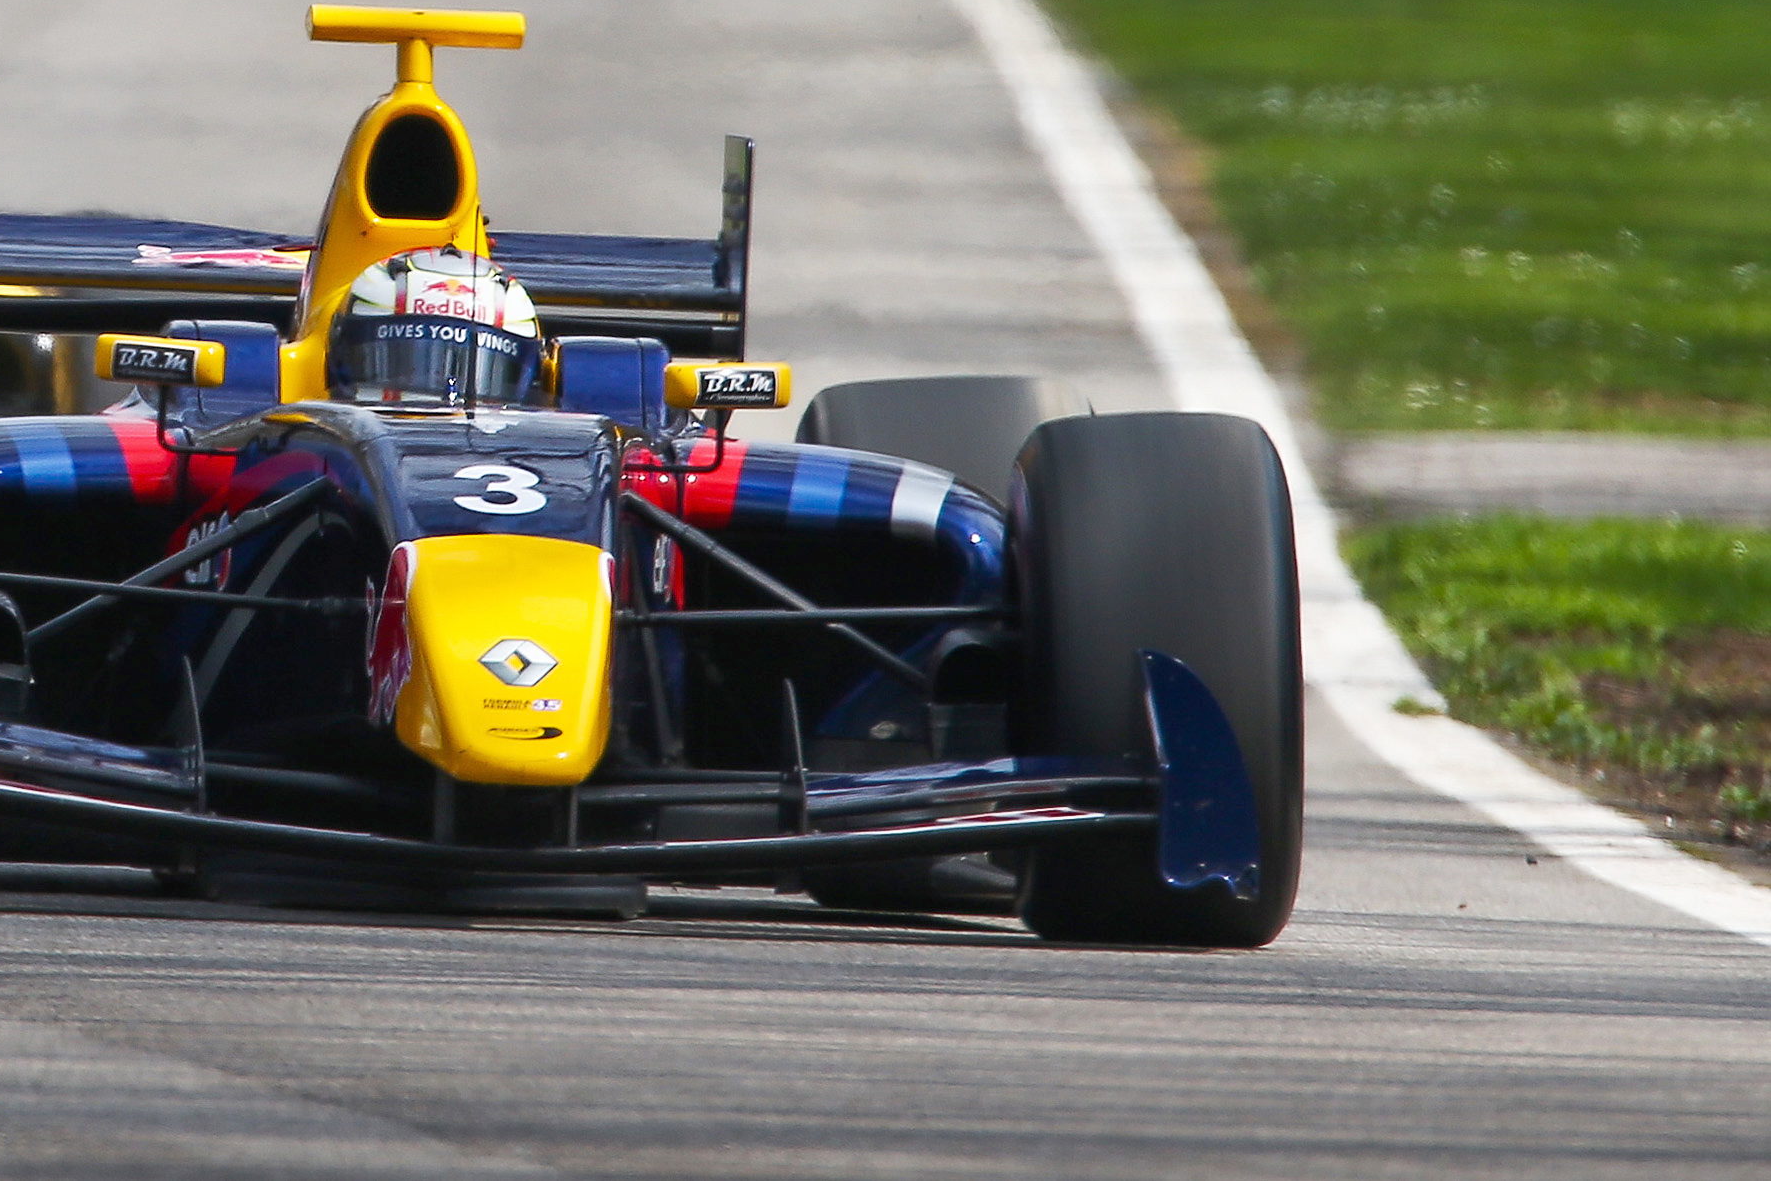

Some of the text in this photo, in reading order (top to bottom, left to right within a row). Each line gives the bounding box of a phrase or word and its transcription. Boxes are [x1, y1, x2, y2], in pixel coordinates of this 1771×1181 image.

[413, 298, 486, 320] Red Bull
[378, 324, 423, 340] GIVES
[429, 325, 468, 343] YOU
[453, 465, 547, 515] 3
